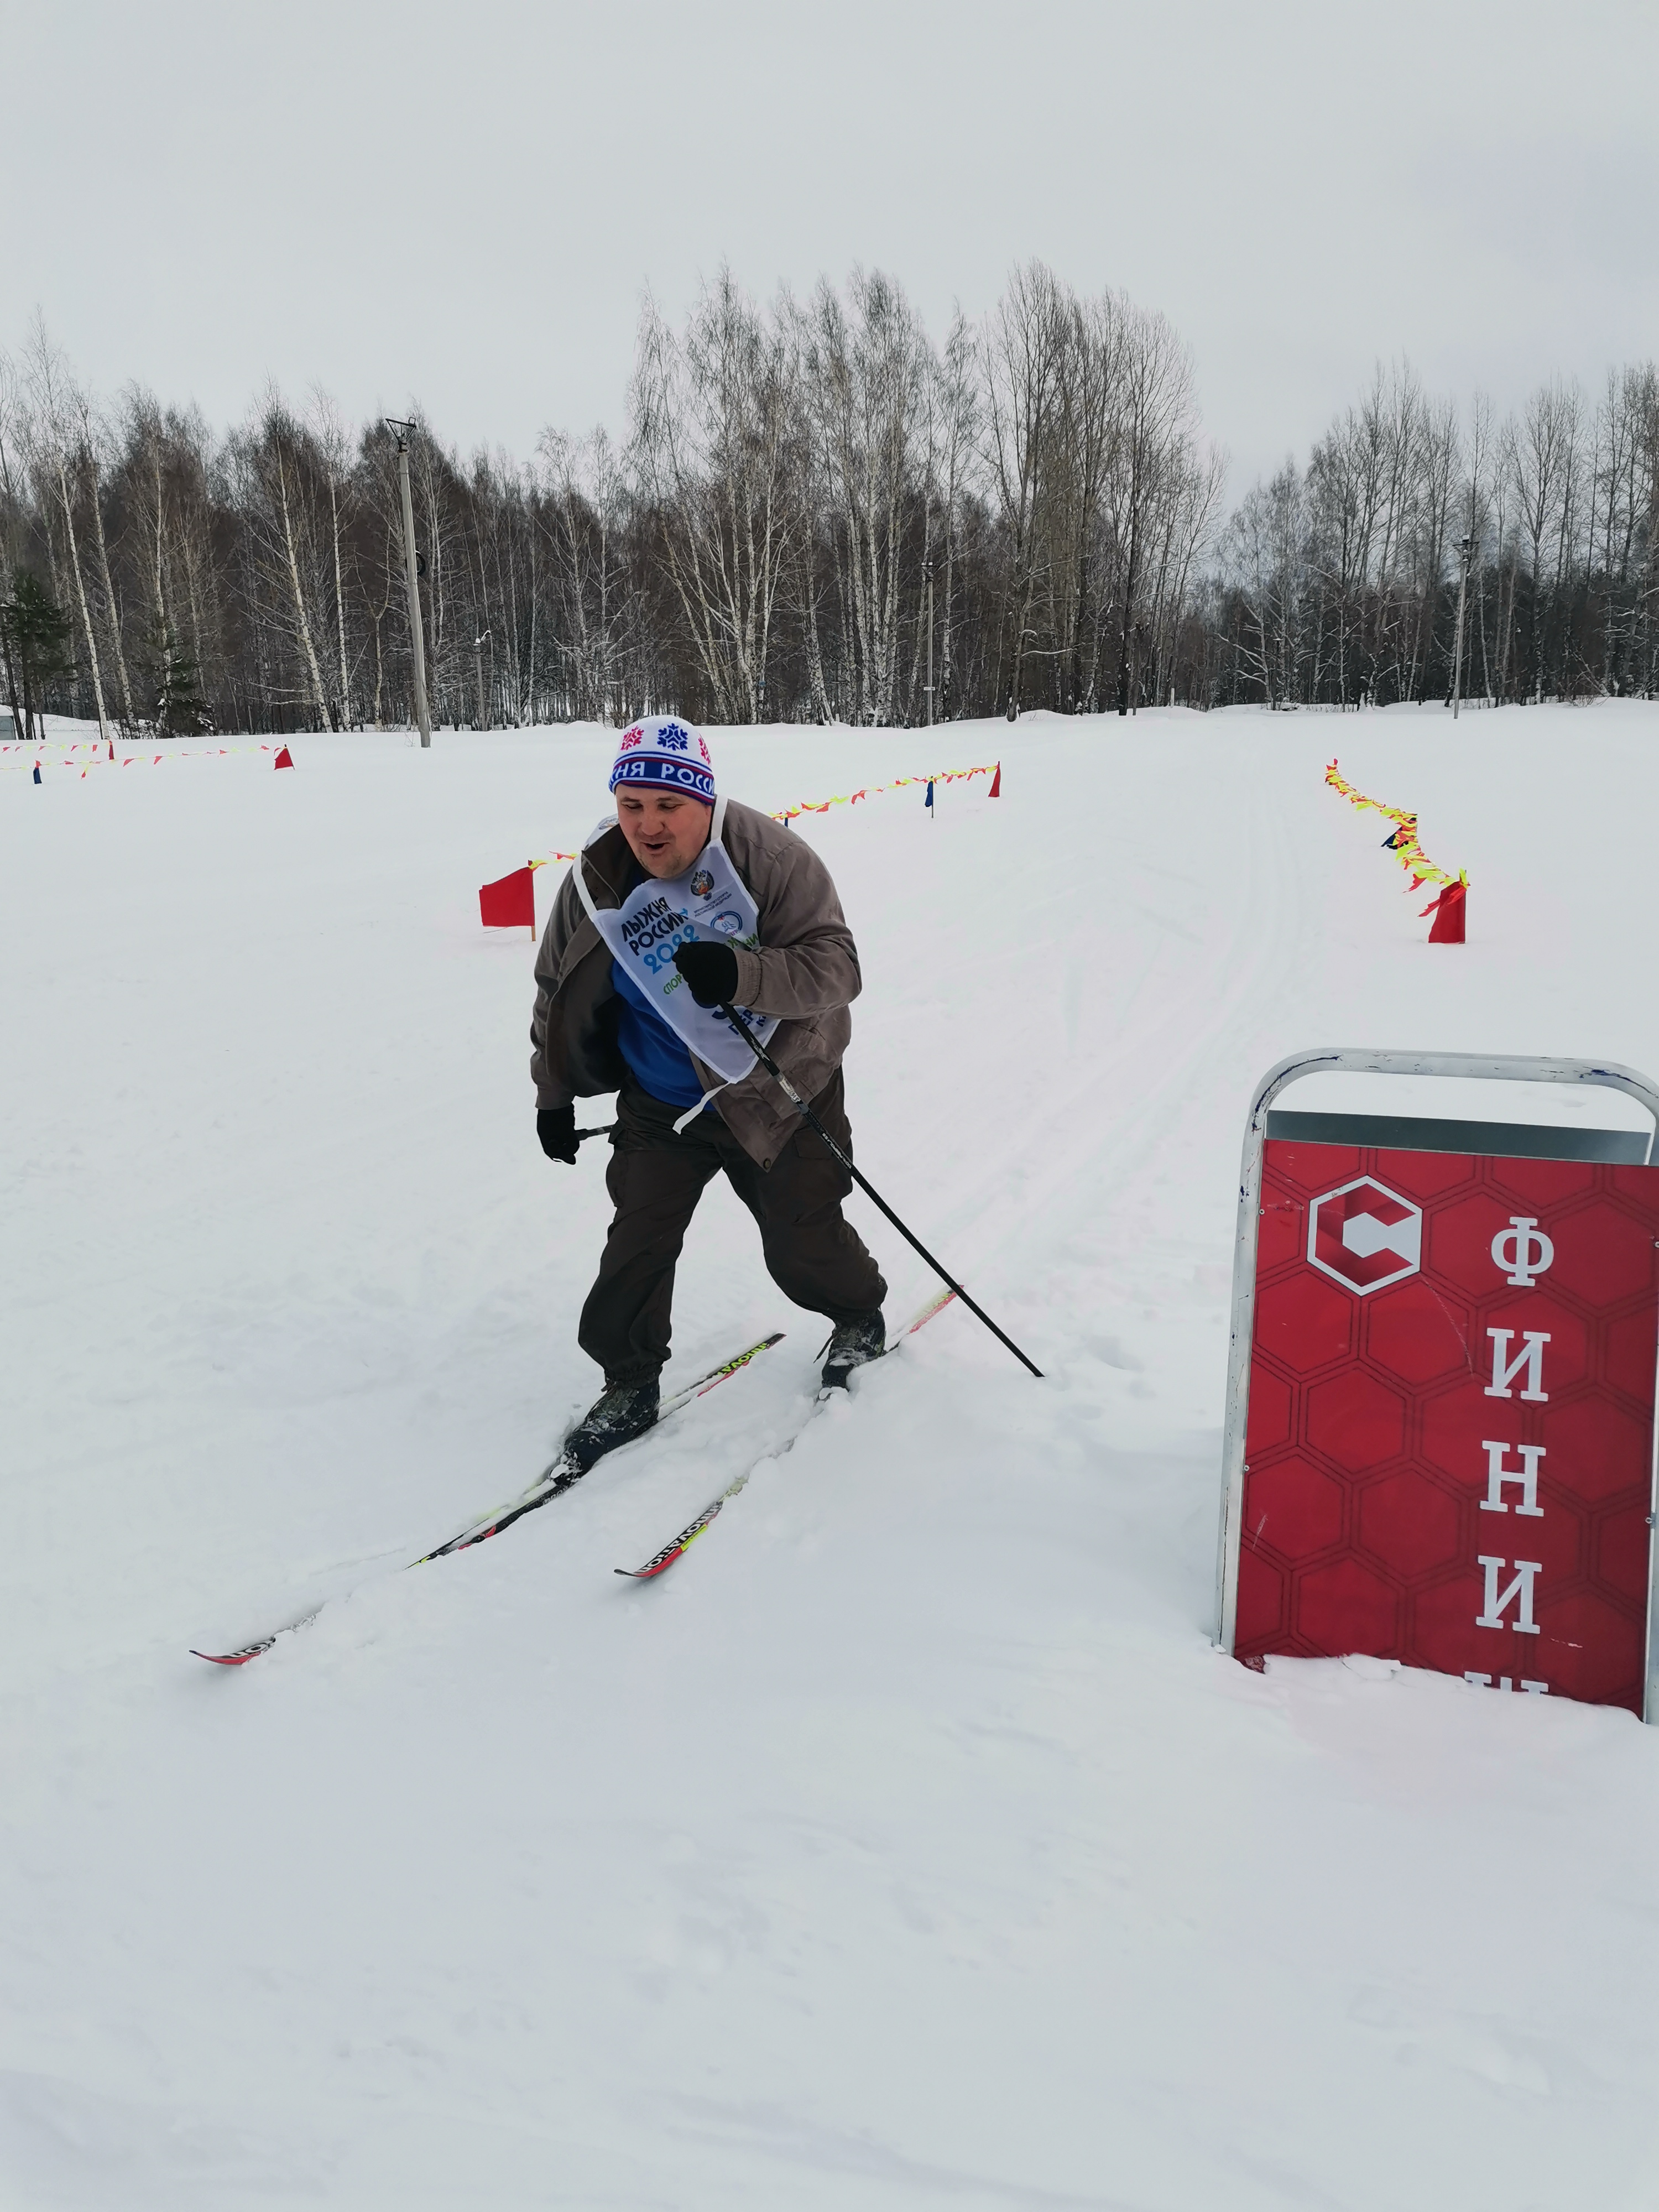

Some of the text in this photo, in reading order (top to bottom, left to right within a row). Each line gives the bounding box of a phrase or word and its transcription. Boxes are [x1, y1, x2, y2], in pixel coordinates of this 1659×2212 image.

[621, 896, 671, 942] ЛЫЖНЯ
[629, 912, 688, 956] РОССИИ
[664, 974, 682, 994] СПОР
[1464, 1217, 1554, 1694] ФИНИ
